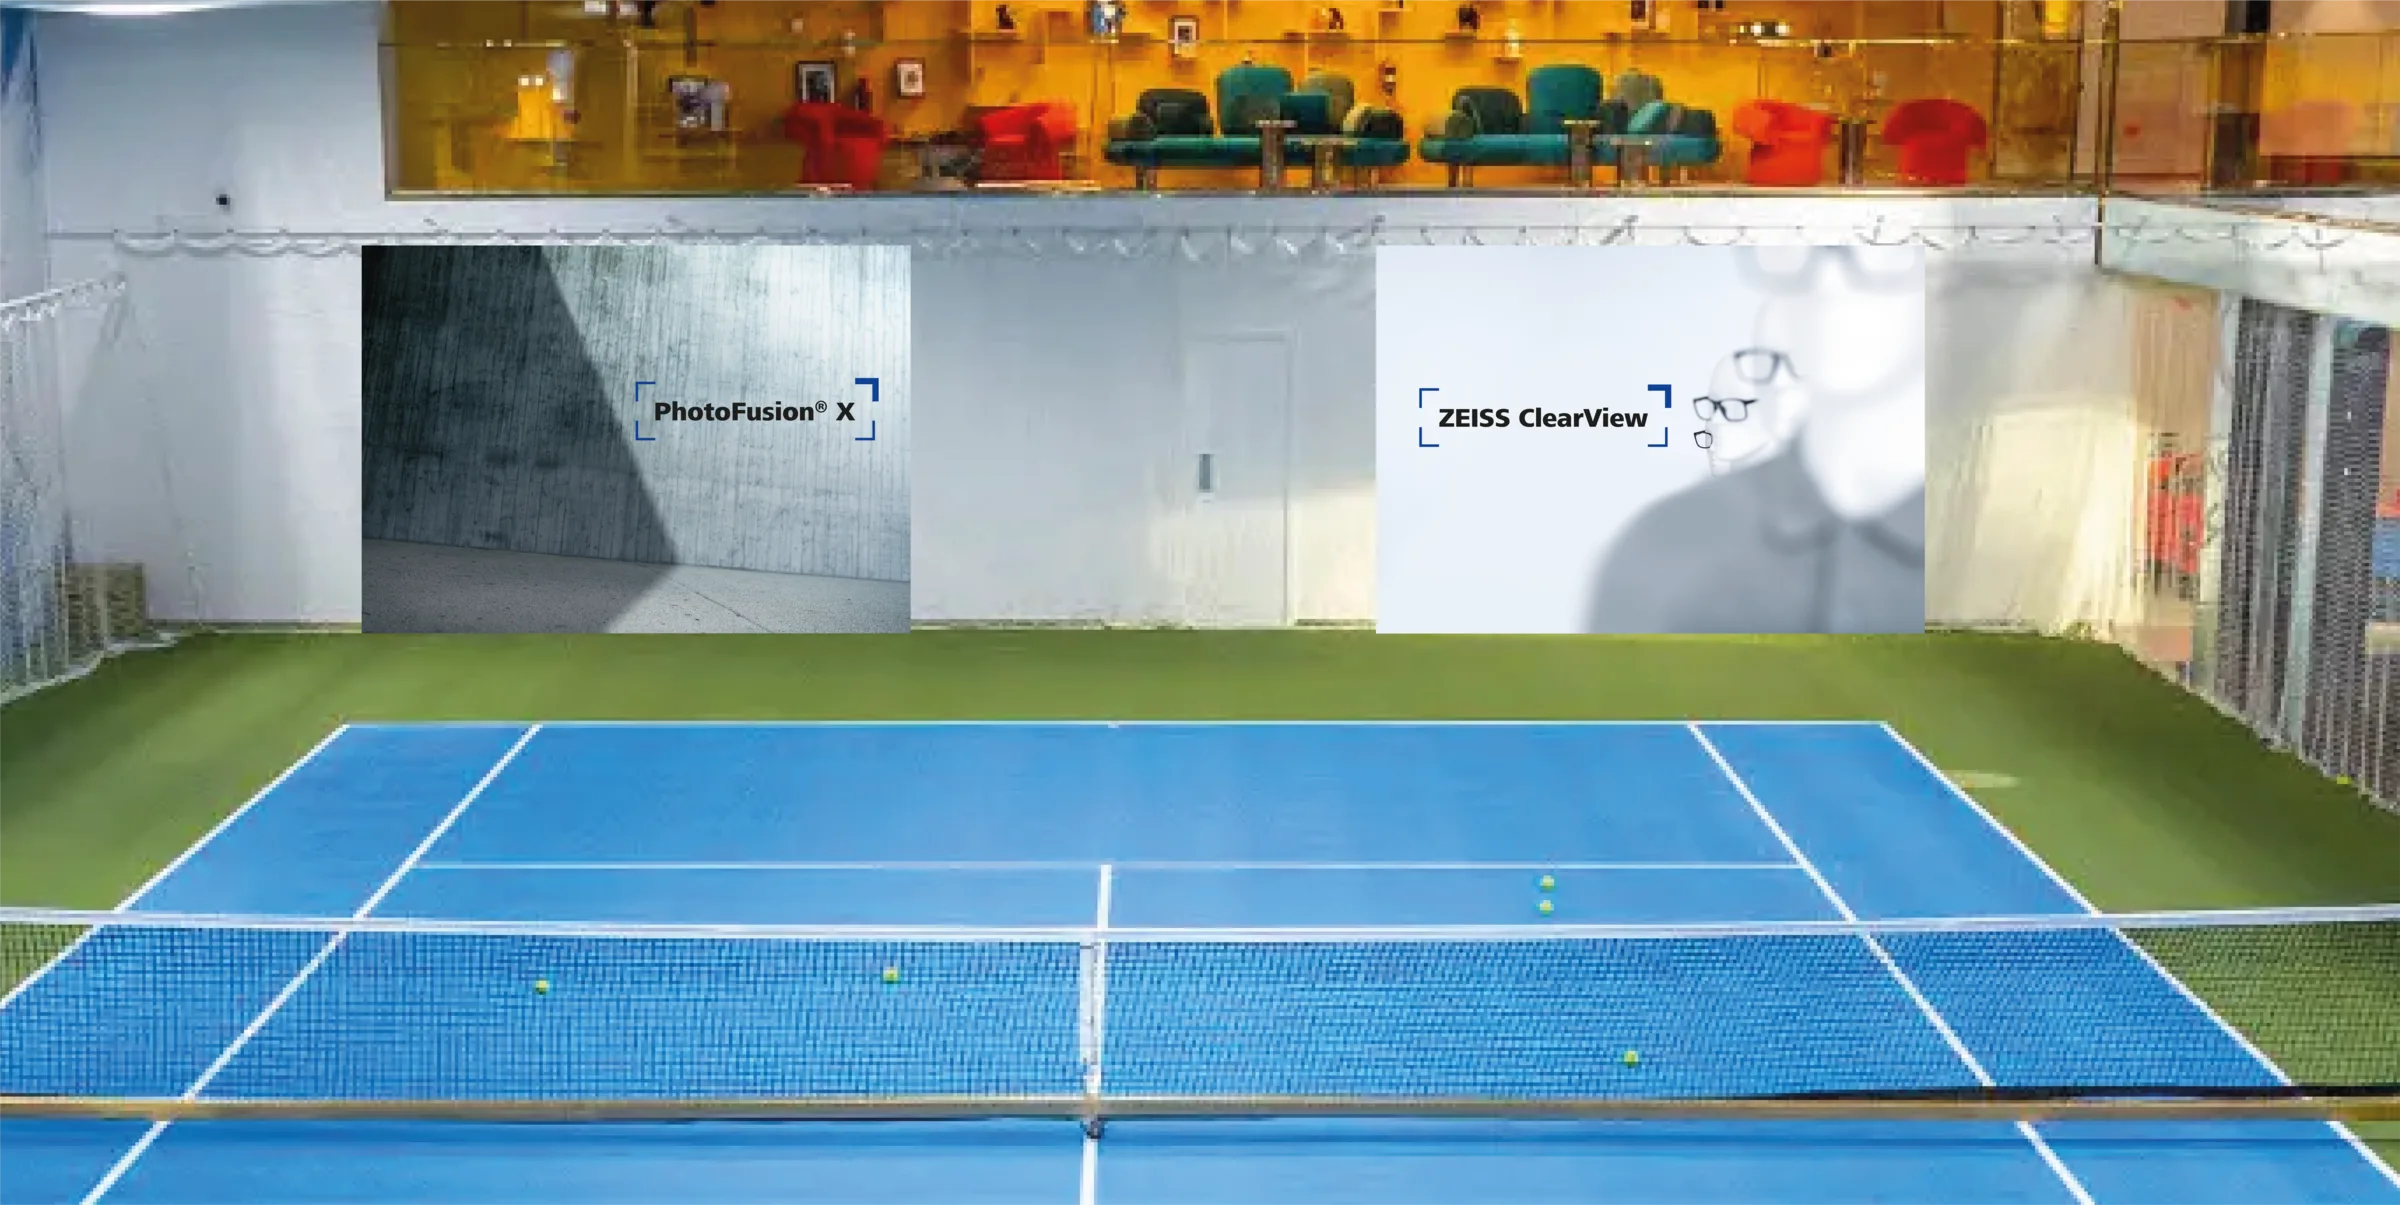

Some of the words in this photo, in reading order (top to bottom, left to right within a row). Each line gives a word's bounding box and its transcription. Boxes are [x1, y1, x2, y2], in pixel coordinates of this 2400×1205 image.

[836, 402, 855, 421] X
[1439, 408, 1510, 428] ZEISS
[1519, 407, 1648, 428] ClearView
